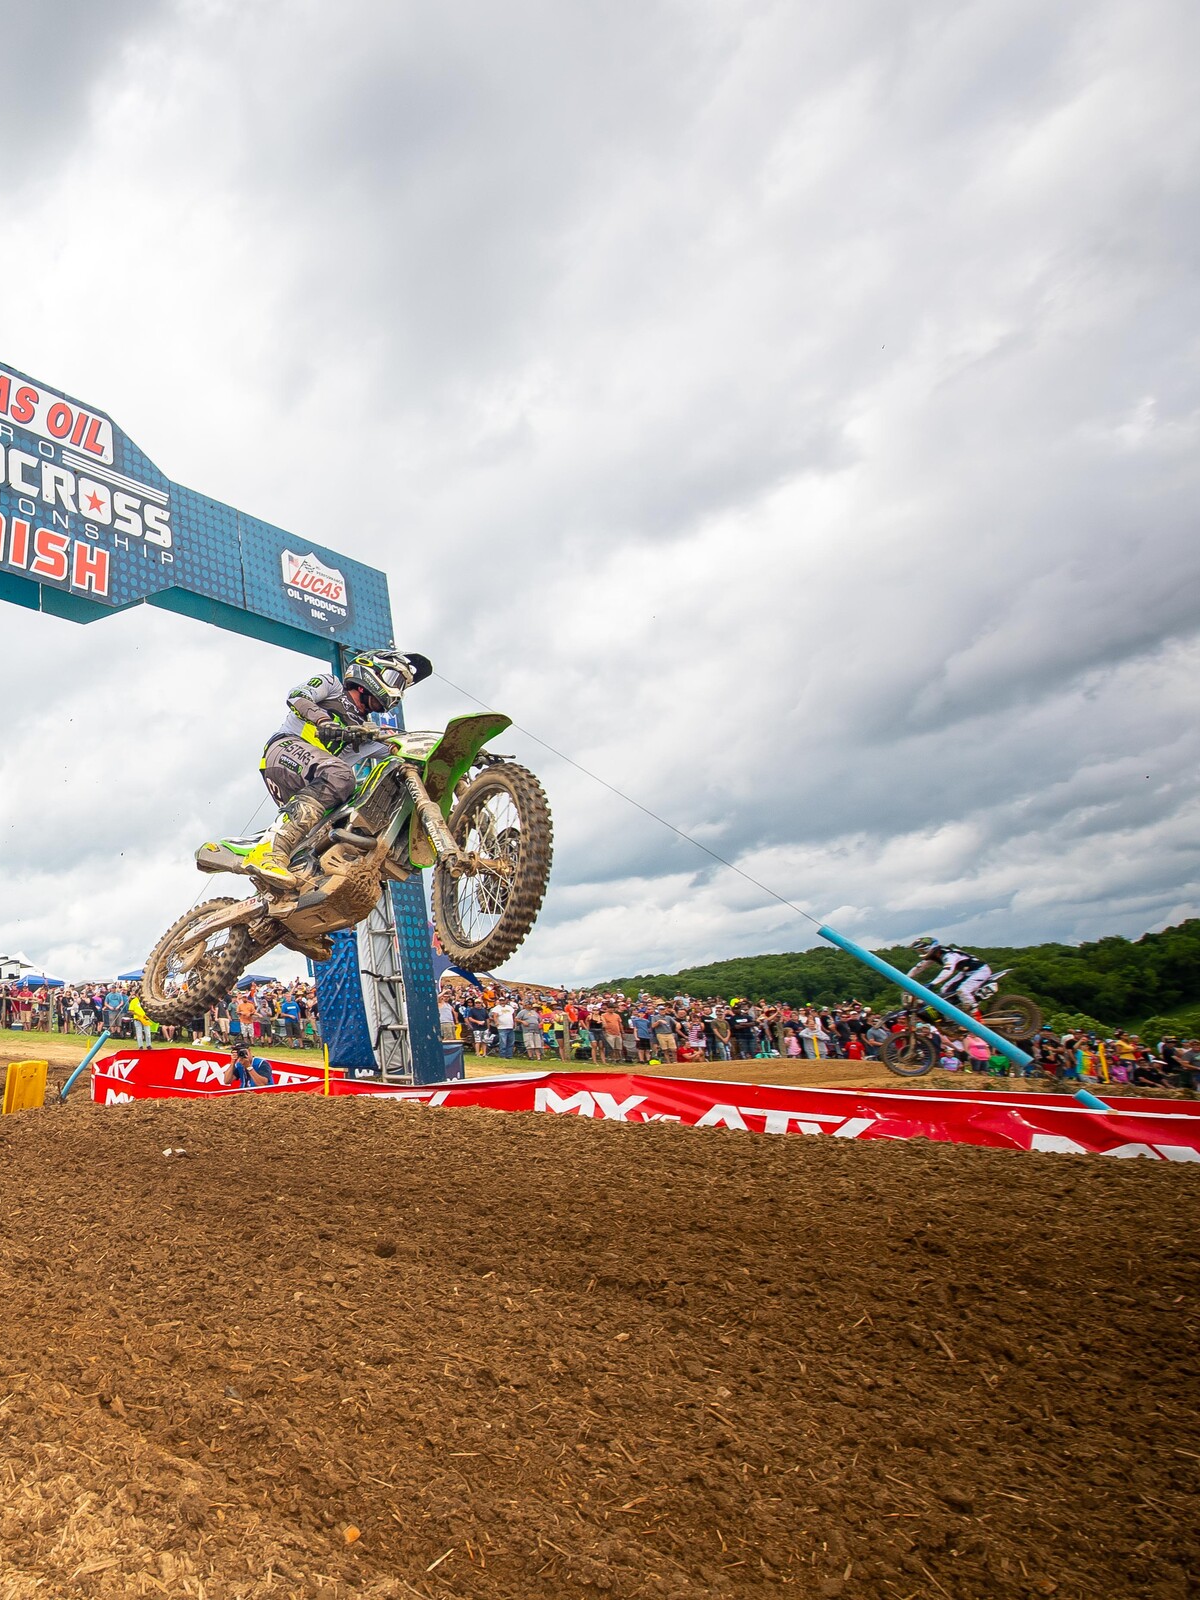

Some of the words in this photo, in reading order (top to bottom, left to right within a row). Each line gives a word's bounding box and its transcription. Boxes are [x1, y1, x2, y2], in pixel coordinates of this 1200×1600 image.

[46, 402, 107, 456] OIL
[290, 570, 343, 600] LUCAS
[287, 588, 303, 600] OIL
[303, 593, 347, 617] PRODUCTS
[311, 608, 329, 622] INC.
[425, 820, 445, 852] DUNLOP
[174, 1057, 232, 1087] MX
